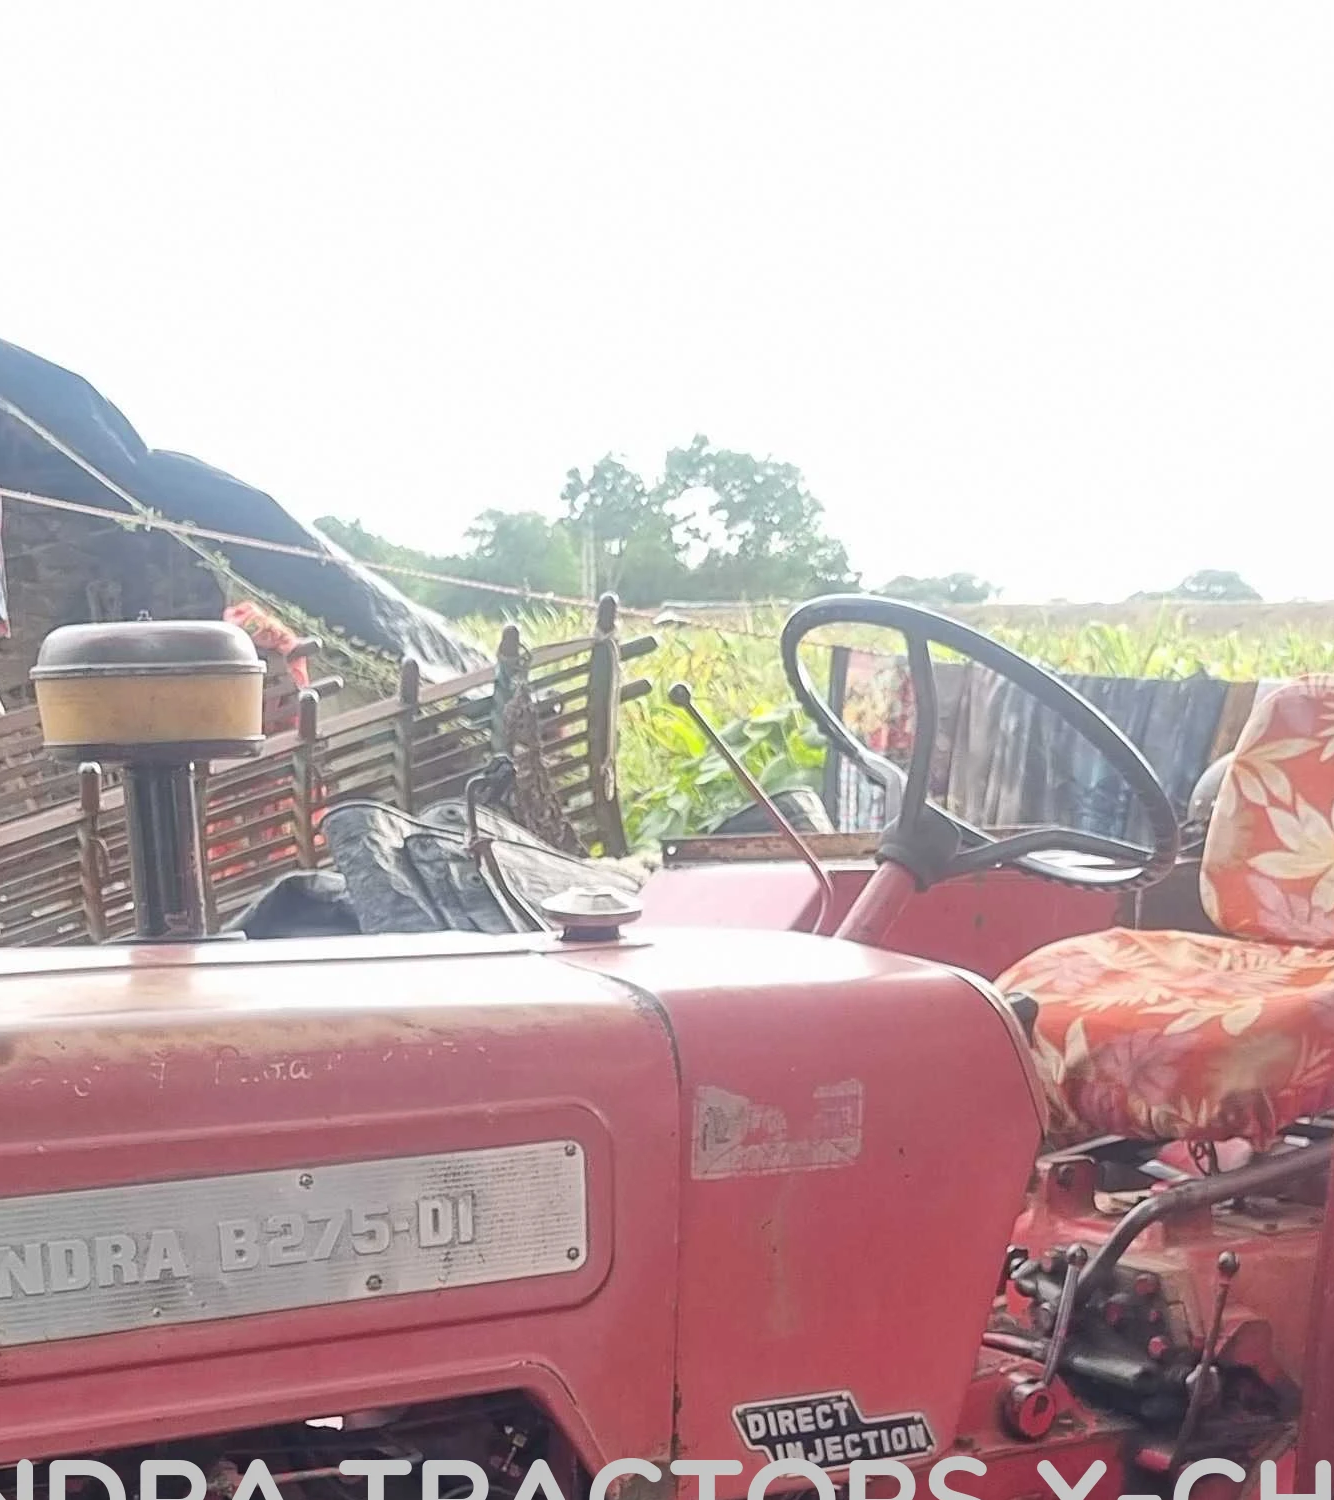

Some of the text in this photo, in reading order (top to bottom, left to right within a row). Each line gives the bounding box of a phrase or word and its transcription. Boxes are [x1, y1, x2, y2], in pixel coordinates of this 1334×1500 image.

[217, 1190, 475, 1273] B275-DI
[746, 1401, 849, 1441] DIRECT
[775, 1424, 928, 1465] INJECTION
